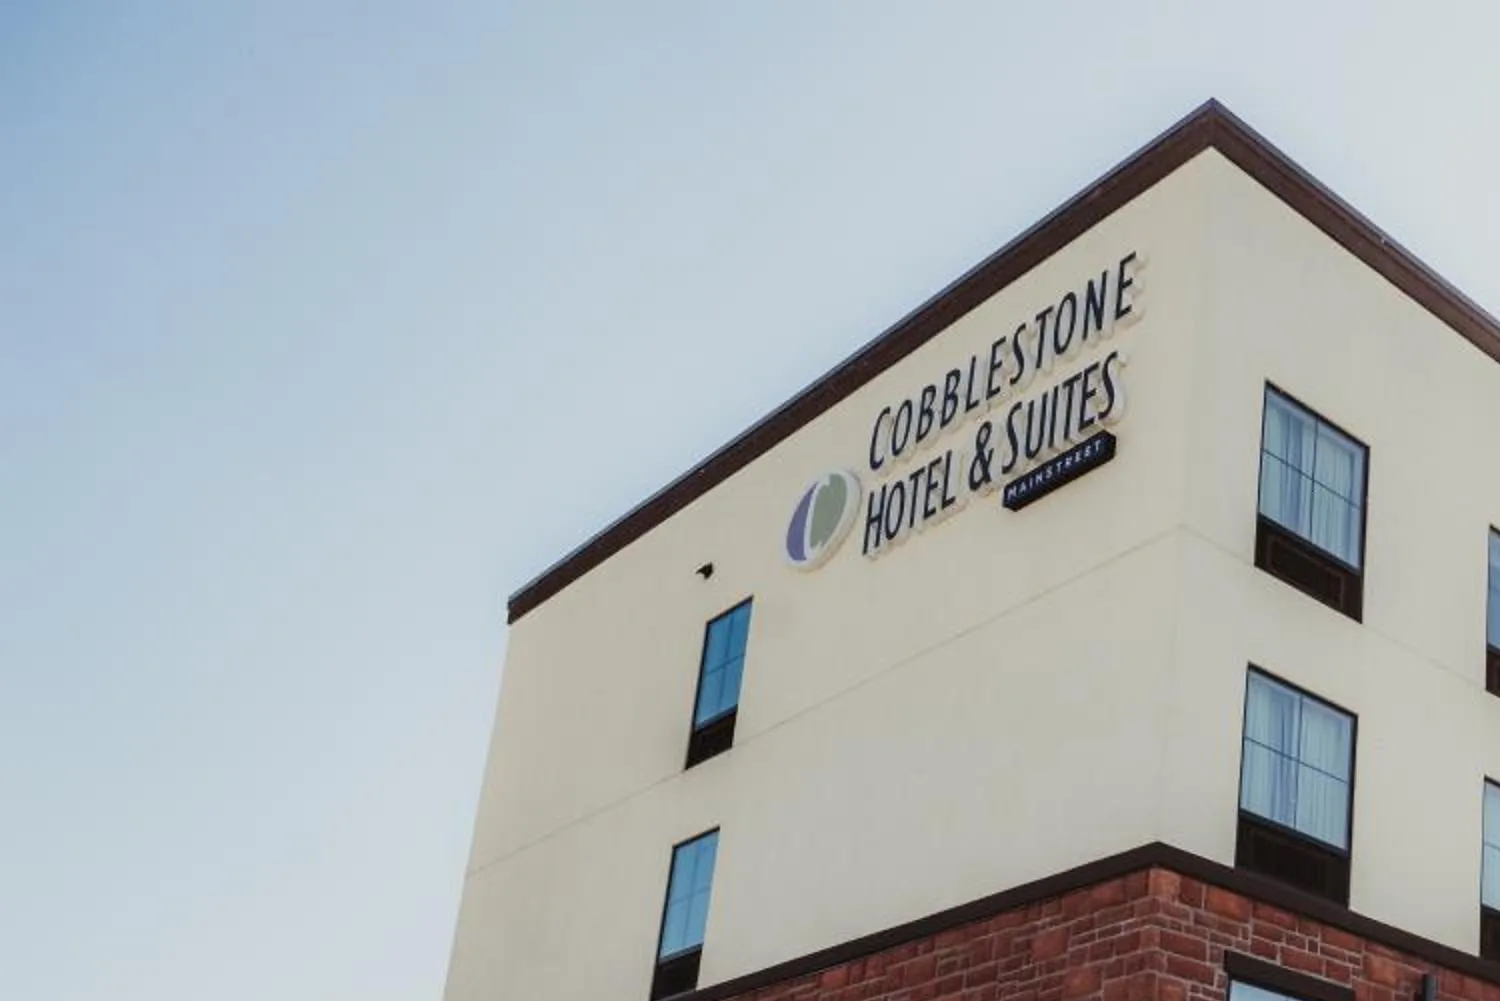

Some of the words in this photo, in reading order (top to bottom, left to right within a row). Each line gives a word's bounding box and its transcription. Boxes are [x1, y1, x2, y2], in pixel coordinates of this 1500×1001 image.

[862, 450, 957, 556] HOTEL
[968, 421, 994, 492] &
[1002, 351, 1118, 475] SUITES
[869, 251, 1137, 470] COBBLESTONE
[1007, 439, 1101, 499] MAINSTREET
